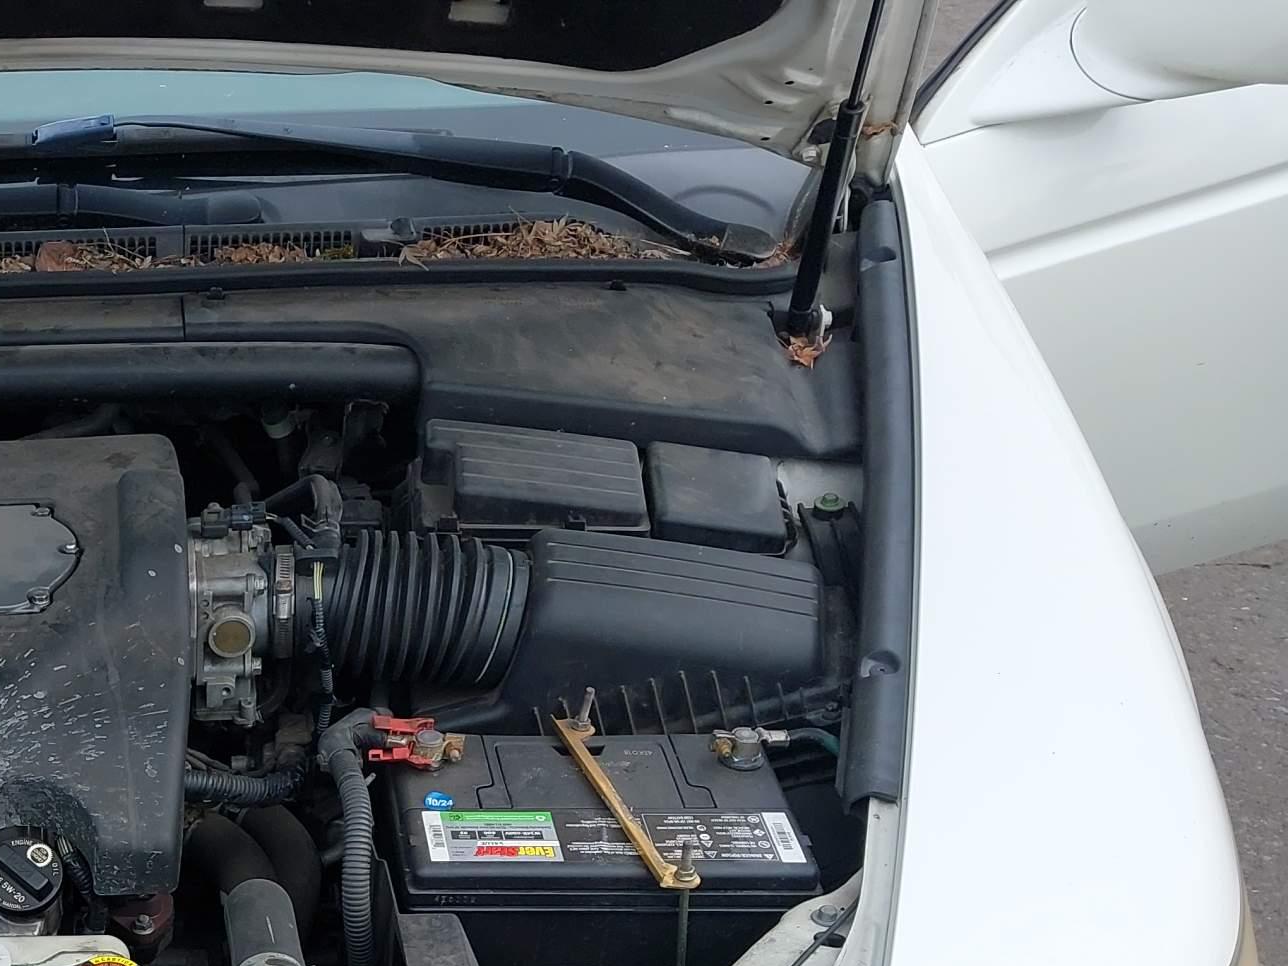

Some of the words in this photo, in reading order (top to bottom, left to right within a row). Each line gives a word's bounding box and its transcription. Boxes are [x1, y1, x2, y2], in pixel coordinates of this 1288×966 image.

[426, 796, 454, 808] 10/24
[11, 839, 34, 847] ENGINE
[51, 862, 60, 877] OIL
[474, 845, 556, 858] EverStart
[1, 881, 26, 904] 5W-20
